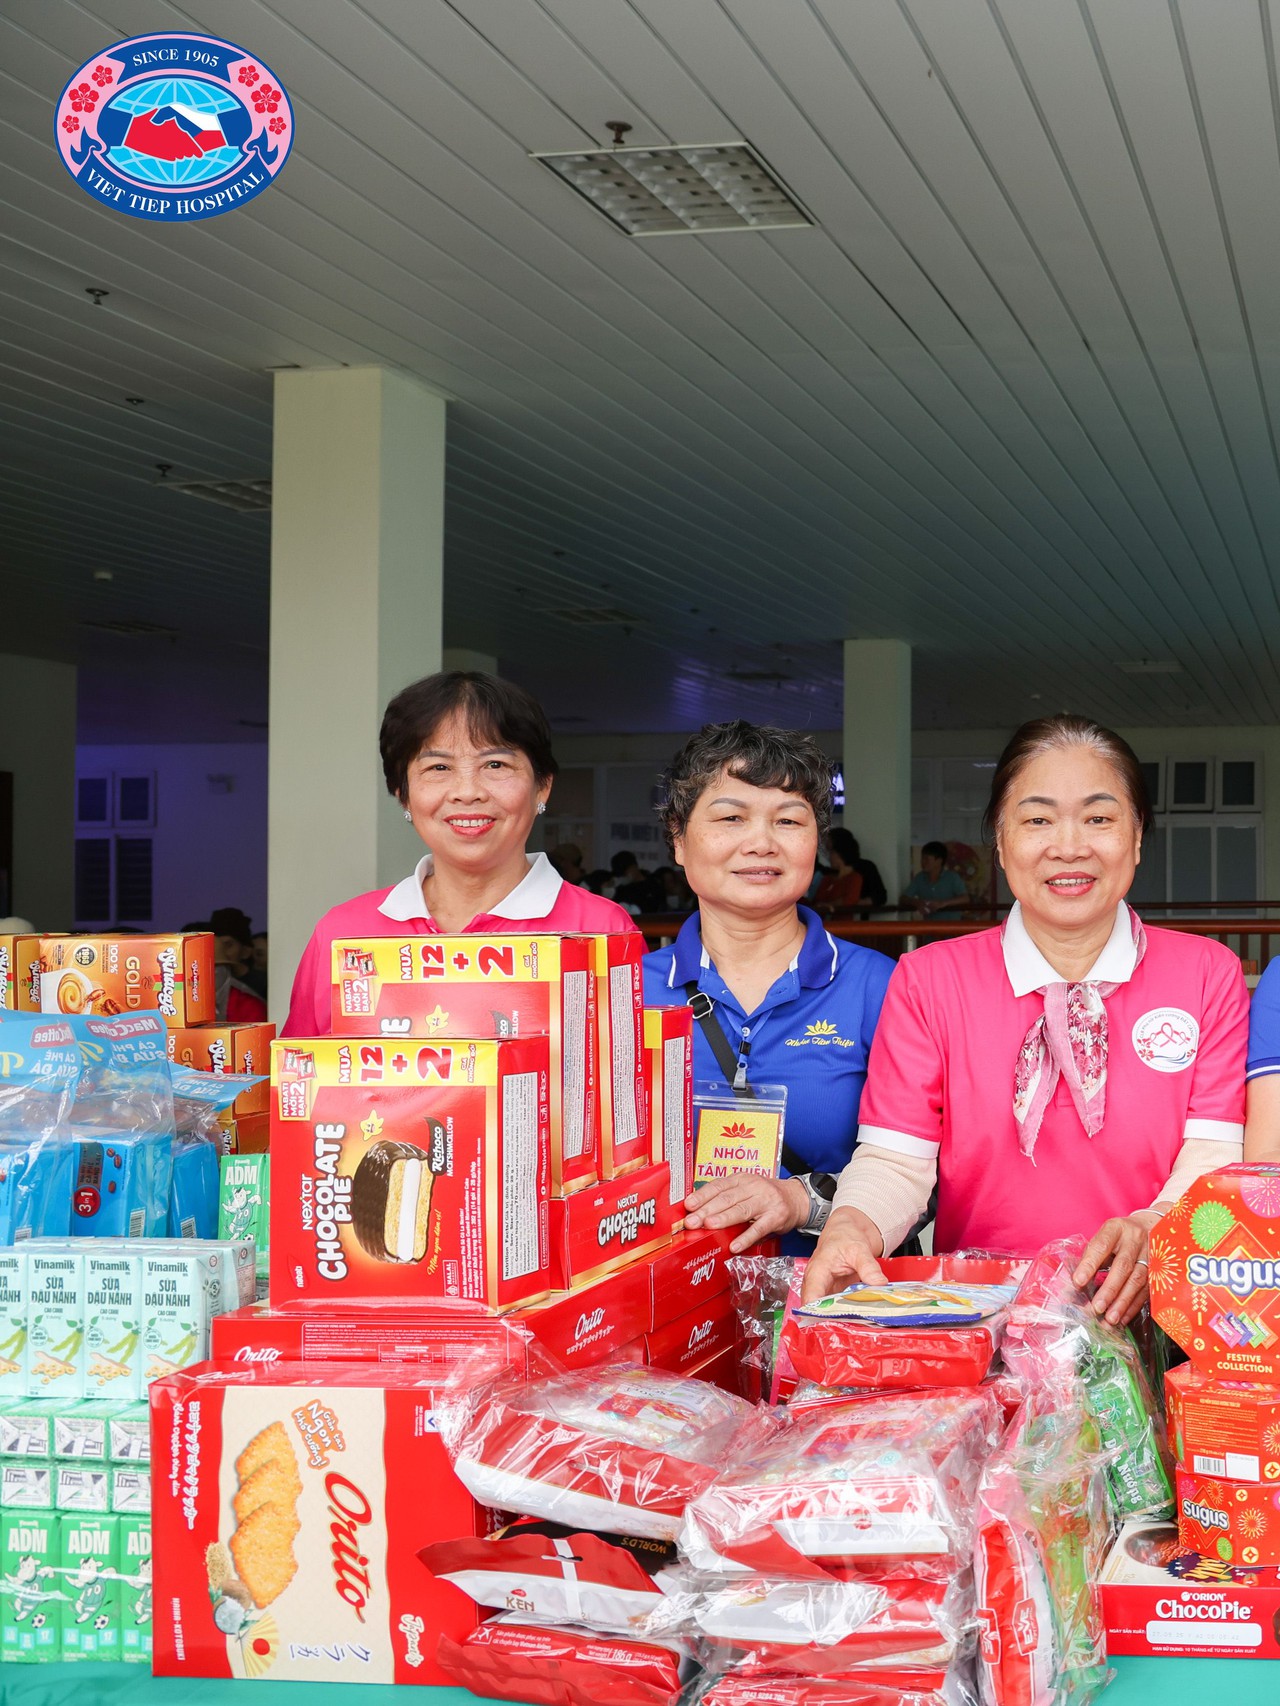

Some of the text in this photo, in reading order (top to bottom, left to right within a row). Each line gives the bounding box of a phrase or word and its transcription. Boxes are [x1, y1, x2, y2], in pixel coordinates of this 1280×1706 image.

[400, 945, 412, 980] MUA
[421, 944, 444, 979] 12
[476, 945, 515, 977] 2
[29, 959, 41, 1003] Vinacafé
[125, 957, 141, 1008] GOLD
[158, 946, 177, 1016] Vinacafé
[338, 1046, 351, 1083] MUA
[360, 1044, 383, 1083] 12
[416, 1045, 454, 1081] 2
[282, 1082, 290, 1117] NABATI
[432, 1126, 443, 1172] Richoco
[713, 1144, 758, 1161] NHÓM
[225, 1165, 258, 1186] ADM
[697, 1162, 728, 1178] TÂM
[315, 1122, 348, 1281] CHOCOLATE
[334, 1175, 352, 1224] PIE
[597, 1198, 656, 1246] CHOCOLATE
[620, 1227, 638, 1245] PIE
[34, 1259, 75, 1270] Vinamilk
[90, 1260, 130, 1271] Vinamilk
[148, 1262, 188, 1273] Vinamilk
[690, 1258, 715, 1286] Orito
[46, 1275, 64, 1290] SỮA
[101, 1276, 120, 1291] SỮA
[159, 1277, 177, 1293] SỮA
[574, 1307, 606, 1340] Orito
[687, 1319, 714, 1350] Orito
[233, 1346, 283, 1361] Orito
[1225, 1352, 1262, 1364] FESTIVE
[1216, 1358, 1274, 1375] COLLECTION
[307, 1401, 331, 1449] Ngon
[1182, 1498, 1230, 1532] sugus
[8, 1528, 48, 1553] ADM
[68, 1530, 110, 1555] ADM
[324, 1470, 373, 1624] Orito
[621, 1536, 667, 1554] WORLD'S
[506, 1595, 535, 1612] KEN
[1155, 1599, 1251, 1620] ChocoPie
[1192, 1593, 1225, 1602] ORION
[400, 1613, 425, 1667] Japan's
